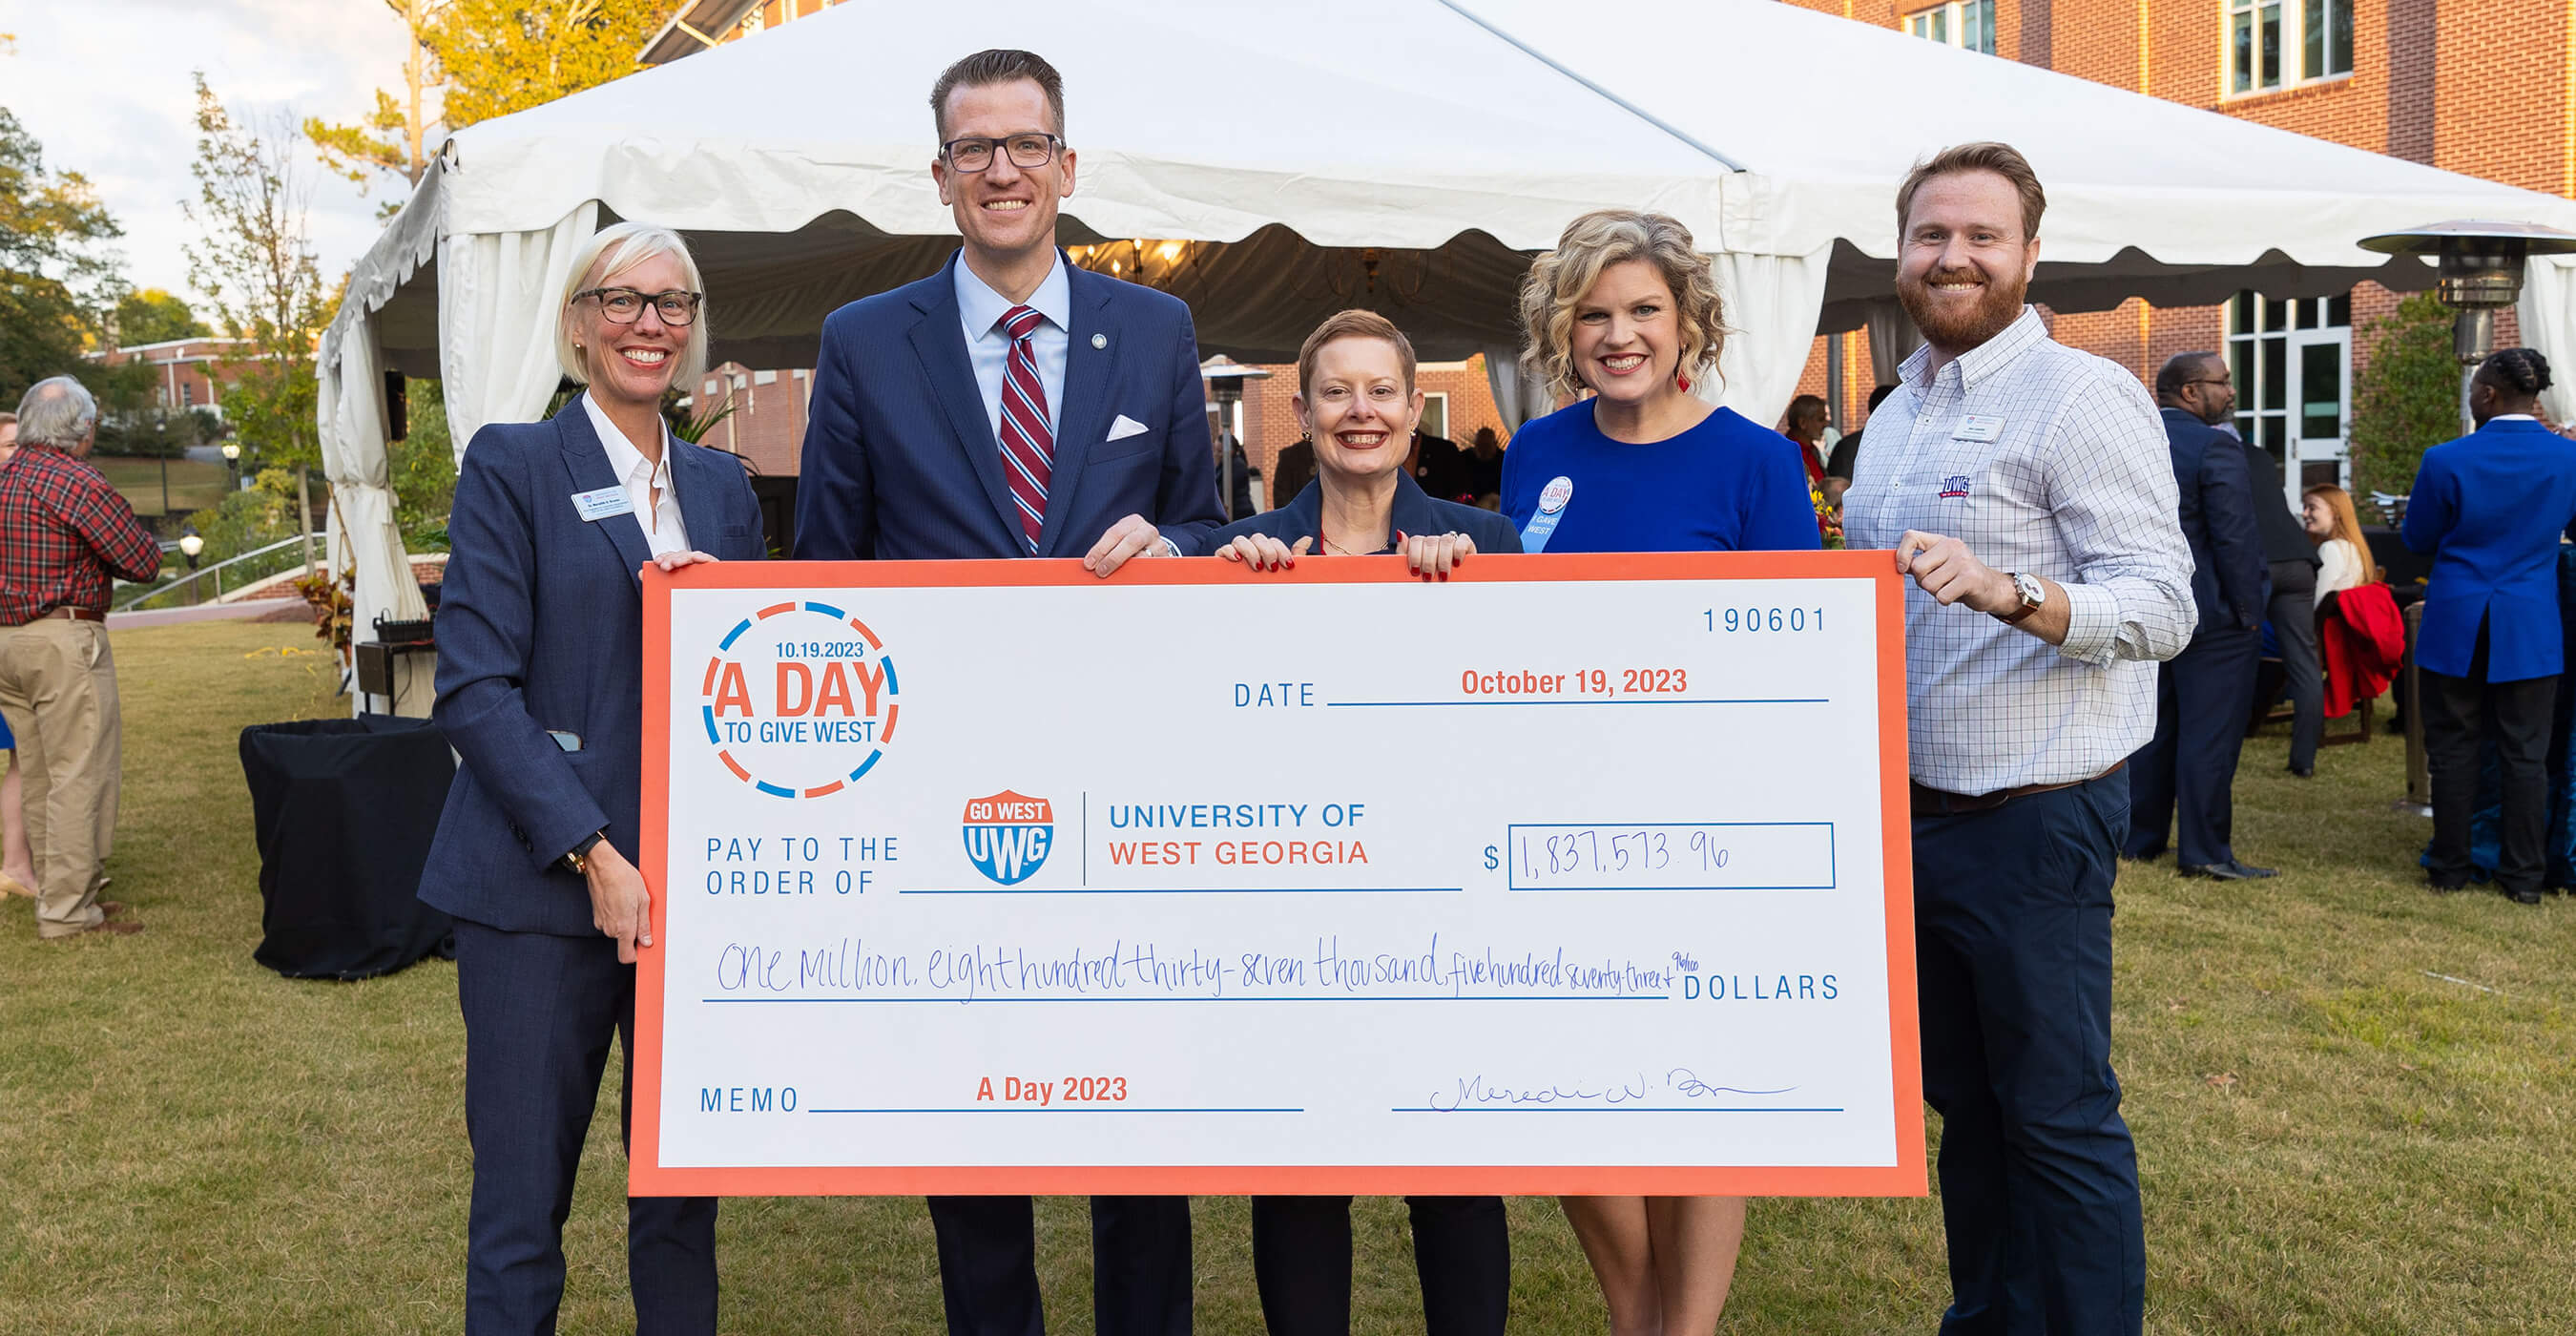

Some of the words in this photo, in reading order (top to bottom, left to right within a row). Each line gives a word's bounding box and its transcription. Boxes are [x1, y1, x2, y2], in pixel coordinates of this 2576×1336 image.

[1942, 475, 1970, 493] UWG
[1527, 526, 1551, 535] WEST
[1536, 515, 1558, 526] GAVE
[1703, 607, 1822, 633] 190601
[776, 641, 864, 658] 10.19.2023
[715, 662, 755, 718] A
[776, 661, 885, 718] DAY
[1235, 682, 1314, 708] DATE
[1462, 669, 1566, 695] October
[1575, 669, 1614, 699] 19,
[1623, 668, 1688, 694] 2023
[724, 720, 752, 743] TO
[759, 720, 808, 743] GIVE
[813, 720, 877, 743] WEST
[969, 802, 993, 820] GO
[997, 802, 1047, 820] WEST
[1110, 804, 1308, 828] UNIVERSITY
[1321, 804, 1365, 827] OF
[707, 837, 762, 862] PAY
[780, 837, 820, 862] TO
[839, 837, 898, 862] THE
[967, 826, 1047, 879] UWG
[1109, 842, 1202, 866] WEST
[1215, 840, 1369, 866] GEORGIA
[1484, 844, 1500, 873] $
[706, 870, 814, 895] ORDER
[835, 869, 873, 895] OF
[1684, 974, 1839, 1000] DOLLARS
[700, 1087, 797, 1113] MEMO
[976, 1076, 995, 1101] A
[1005, 1075, 1054, 1107] Day
[1063, 1076, 1128, 1101] 2023
